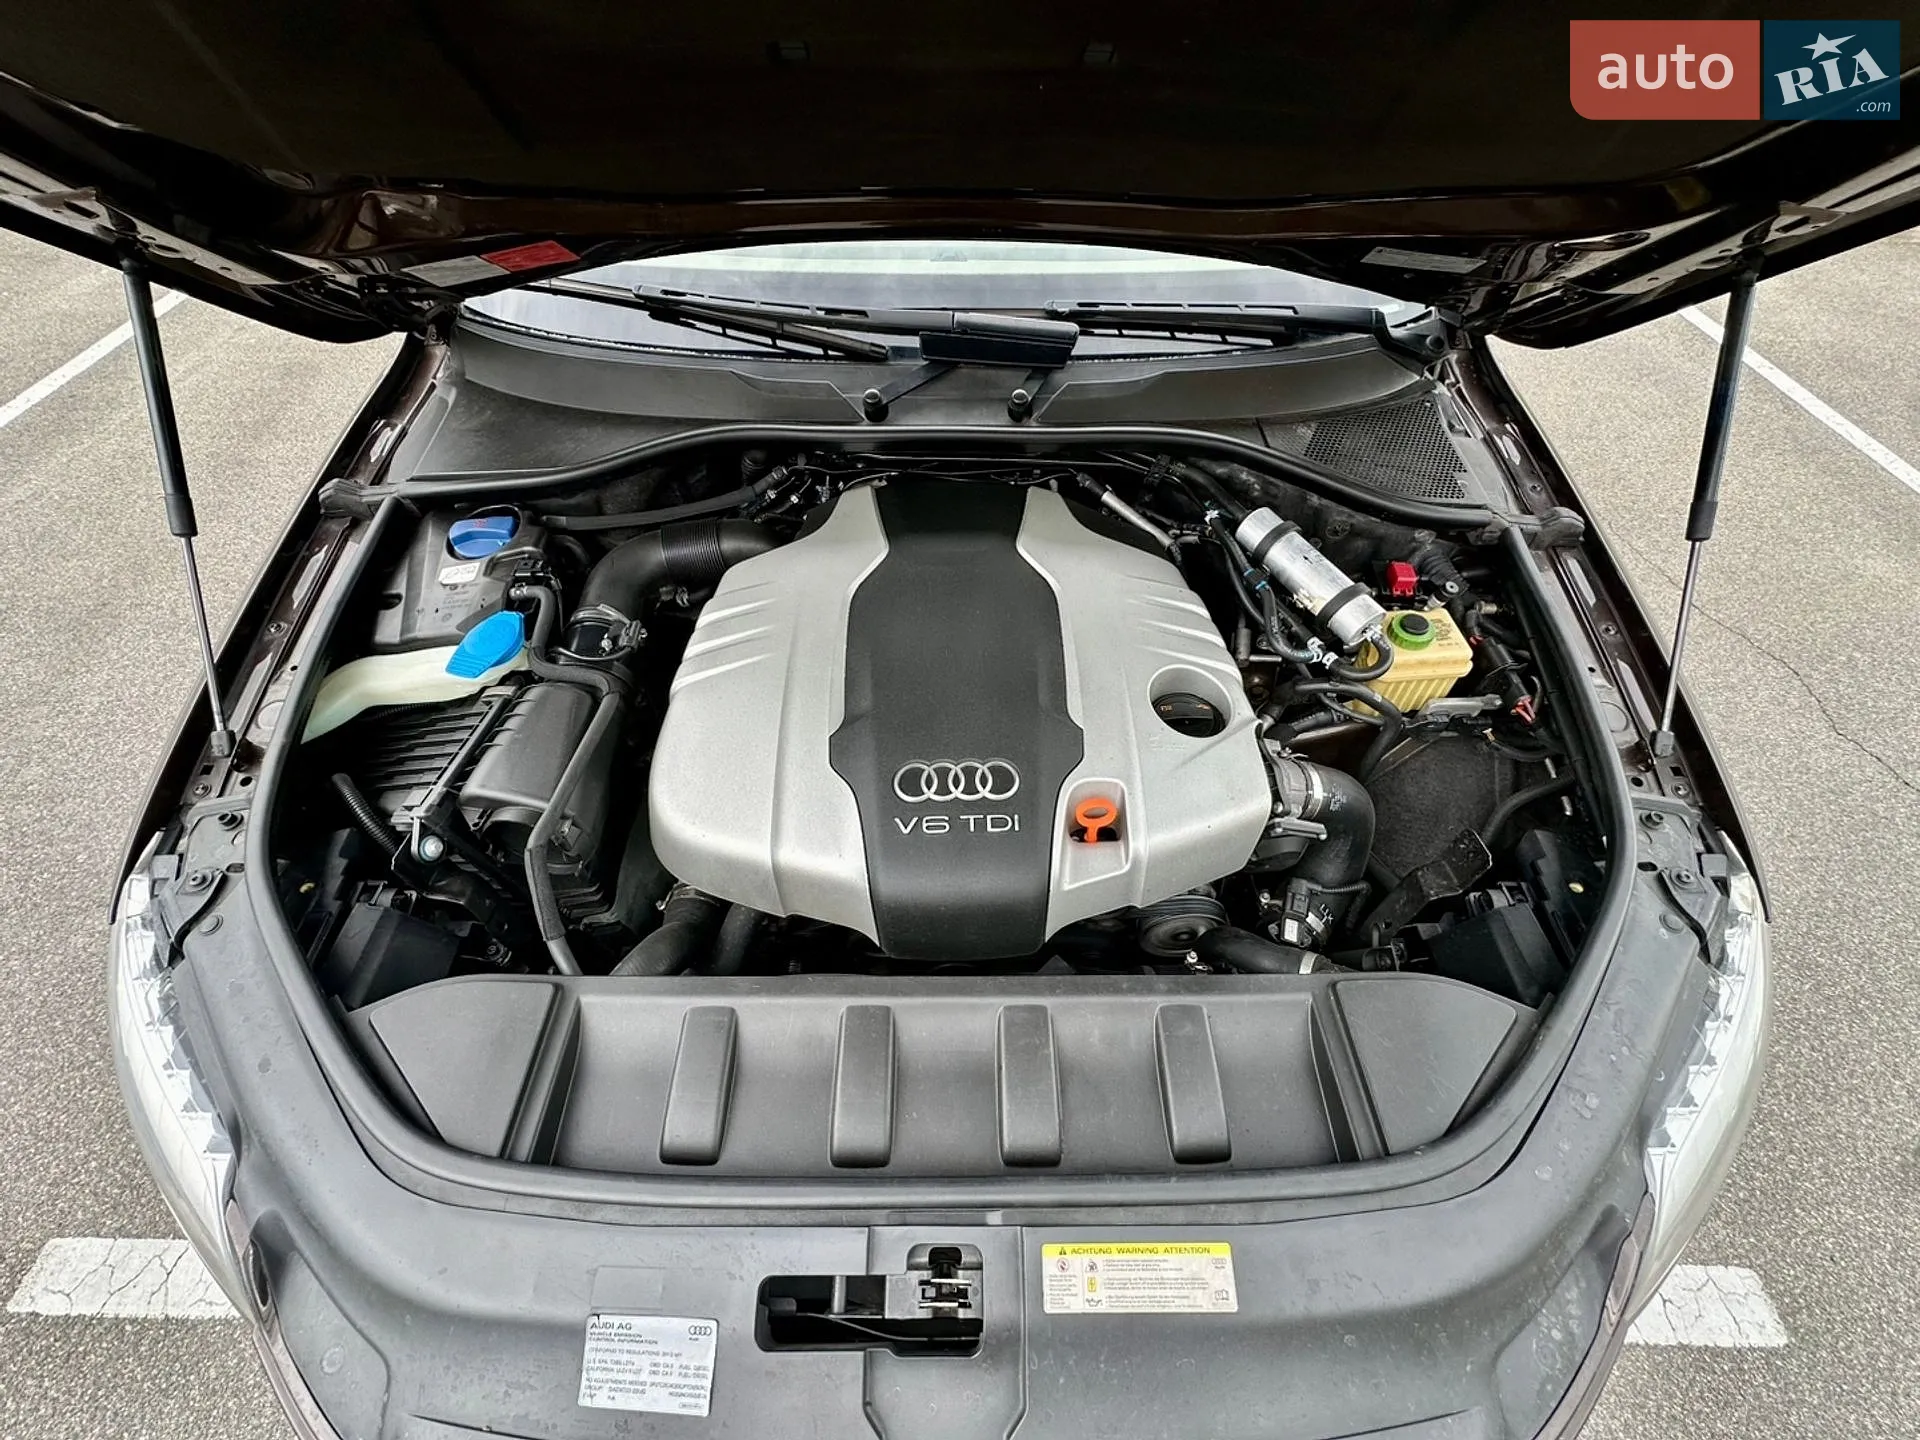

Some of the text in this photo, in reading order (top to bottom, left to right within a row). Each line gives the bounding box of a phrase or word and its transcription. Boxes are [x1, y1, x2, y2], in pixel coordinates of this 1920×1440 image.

[894, 814, 1020, 835] V6 TDI
[1070, 1246, 1211, 1255] ACHTUNG WARNING ATTENTION
[590, 1322, 632, 1331] AUDI AG
